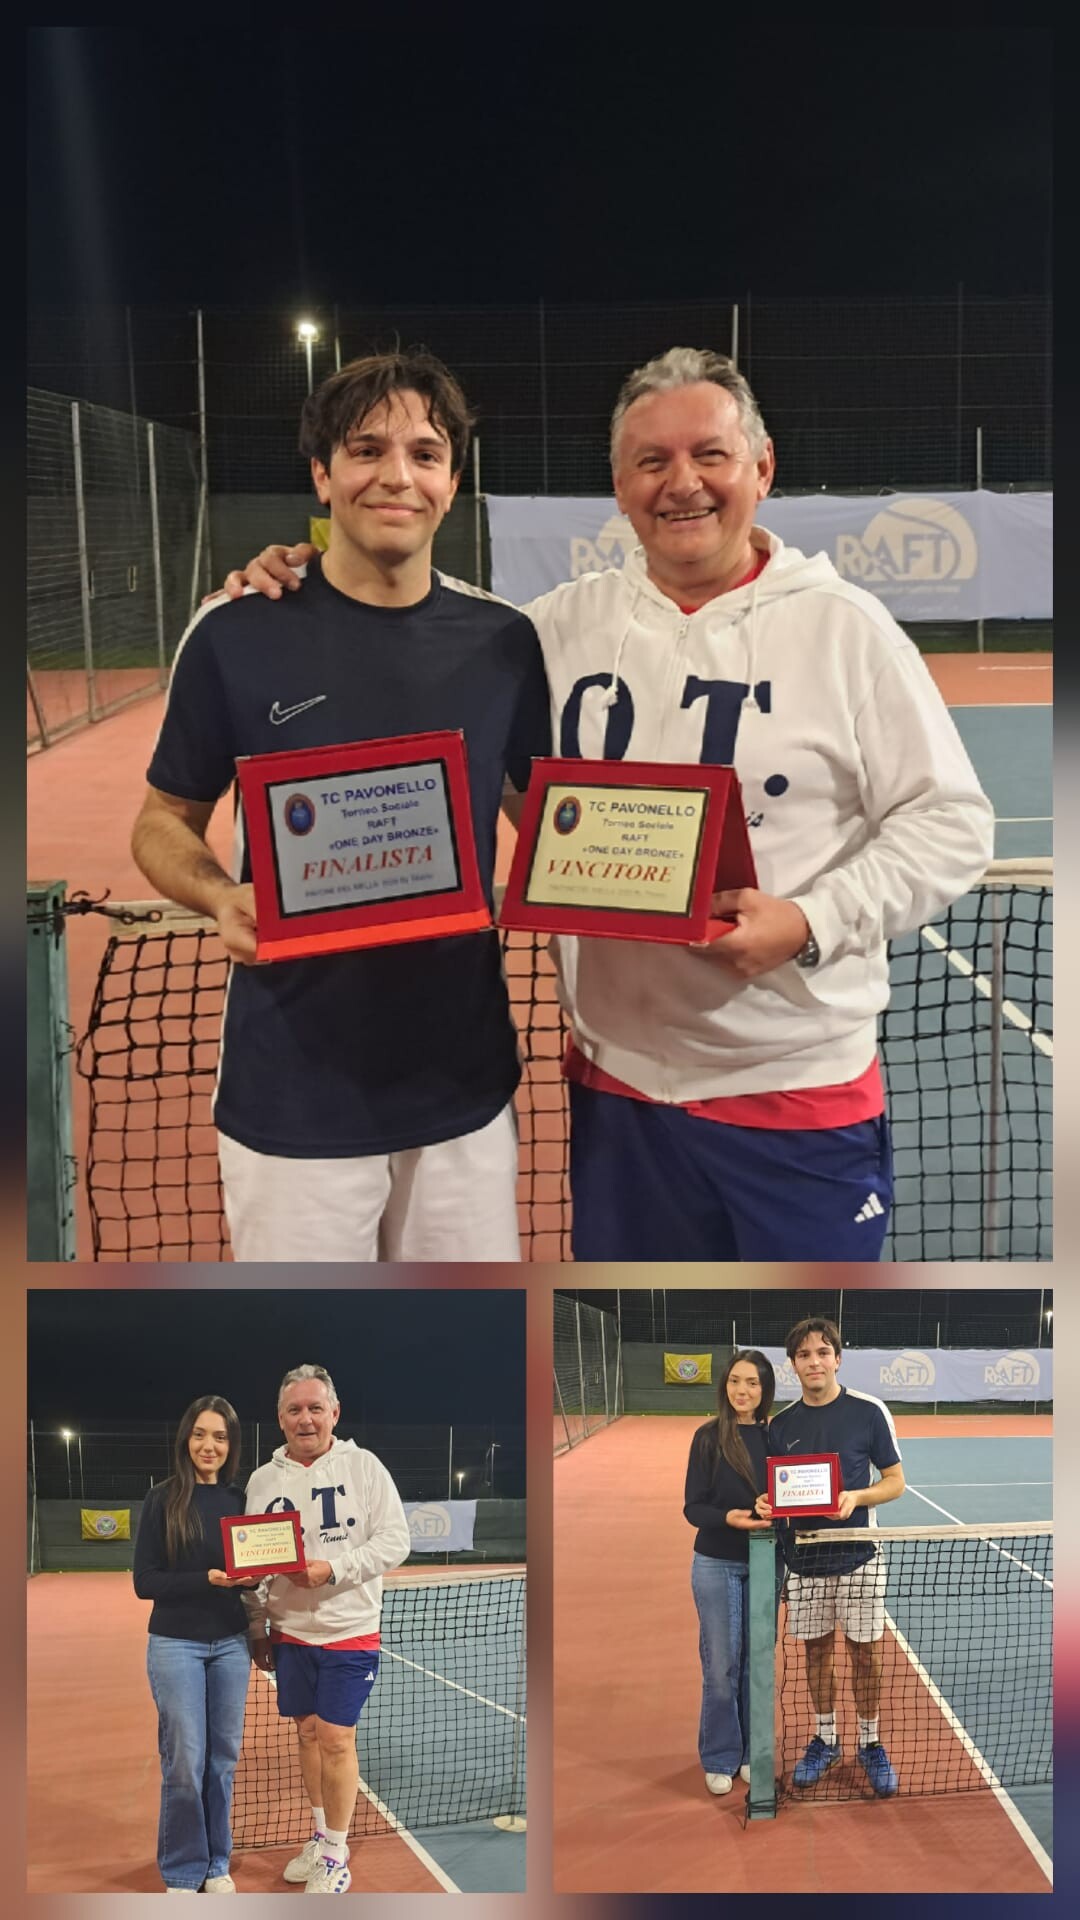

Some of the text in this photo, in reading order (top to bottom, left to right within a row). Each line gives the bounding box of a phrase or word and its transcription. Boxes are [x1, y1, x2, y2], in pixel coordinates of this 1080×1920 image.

[569, 536, 625, 579] RA
[836, 534, 948, 576] RAFT
[320, 779, 437, 805] TC PAVONELLO
[341, 800, 419, 818] Torneo Sociale
[590, 801, 695, 817] TC PAVONELLO
[367, 816, 397, 829] RAFT
[603, 818, 674, 830] Torneo Sociale
[362, 834, 384, 846] DAY
[621, 833, 649, 842] RAFT
[612, 846, 632, 856] DAY
[303, 844, 433, 880] FINALISTA
[548, 859, 676, 883] VINCITORE
[880, 1366, 924, 1384] RAFT
[984, 1366, 1031, 1384] RAFT
[410, 1518, 442, 1534] AFT
[240, 1547, 288, 1557] VINCITORE
